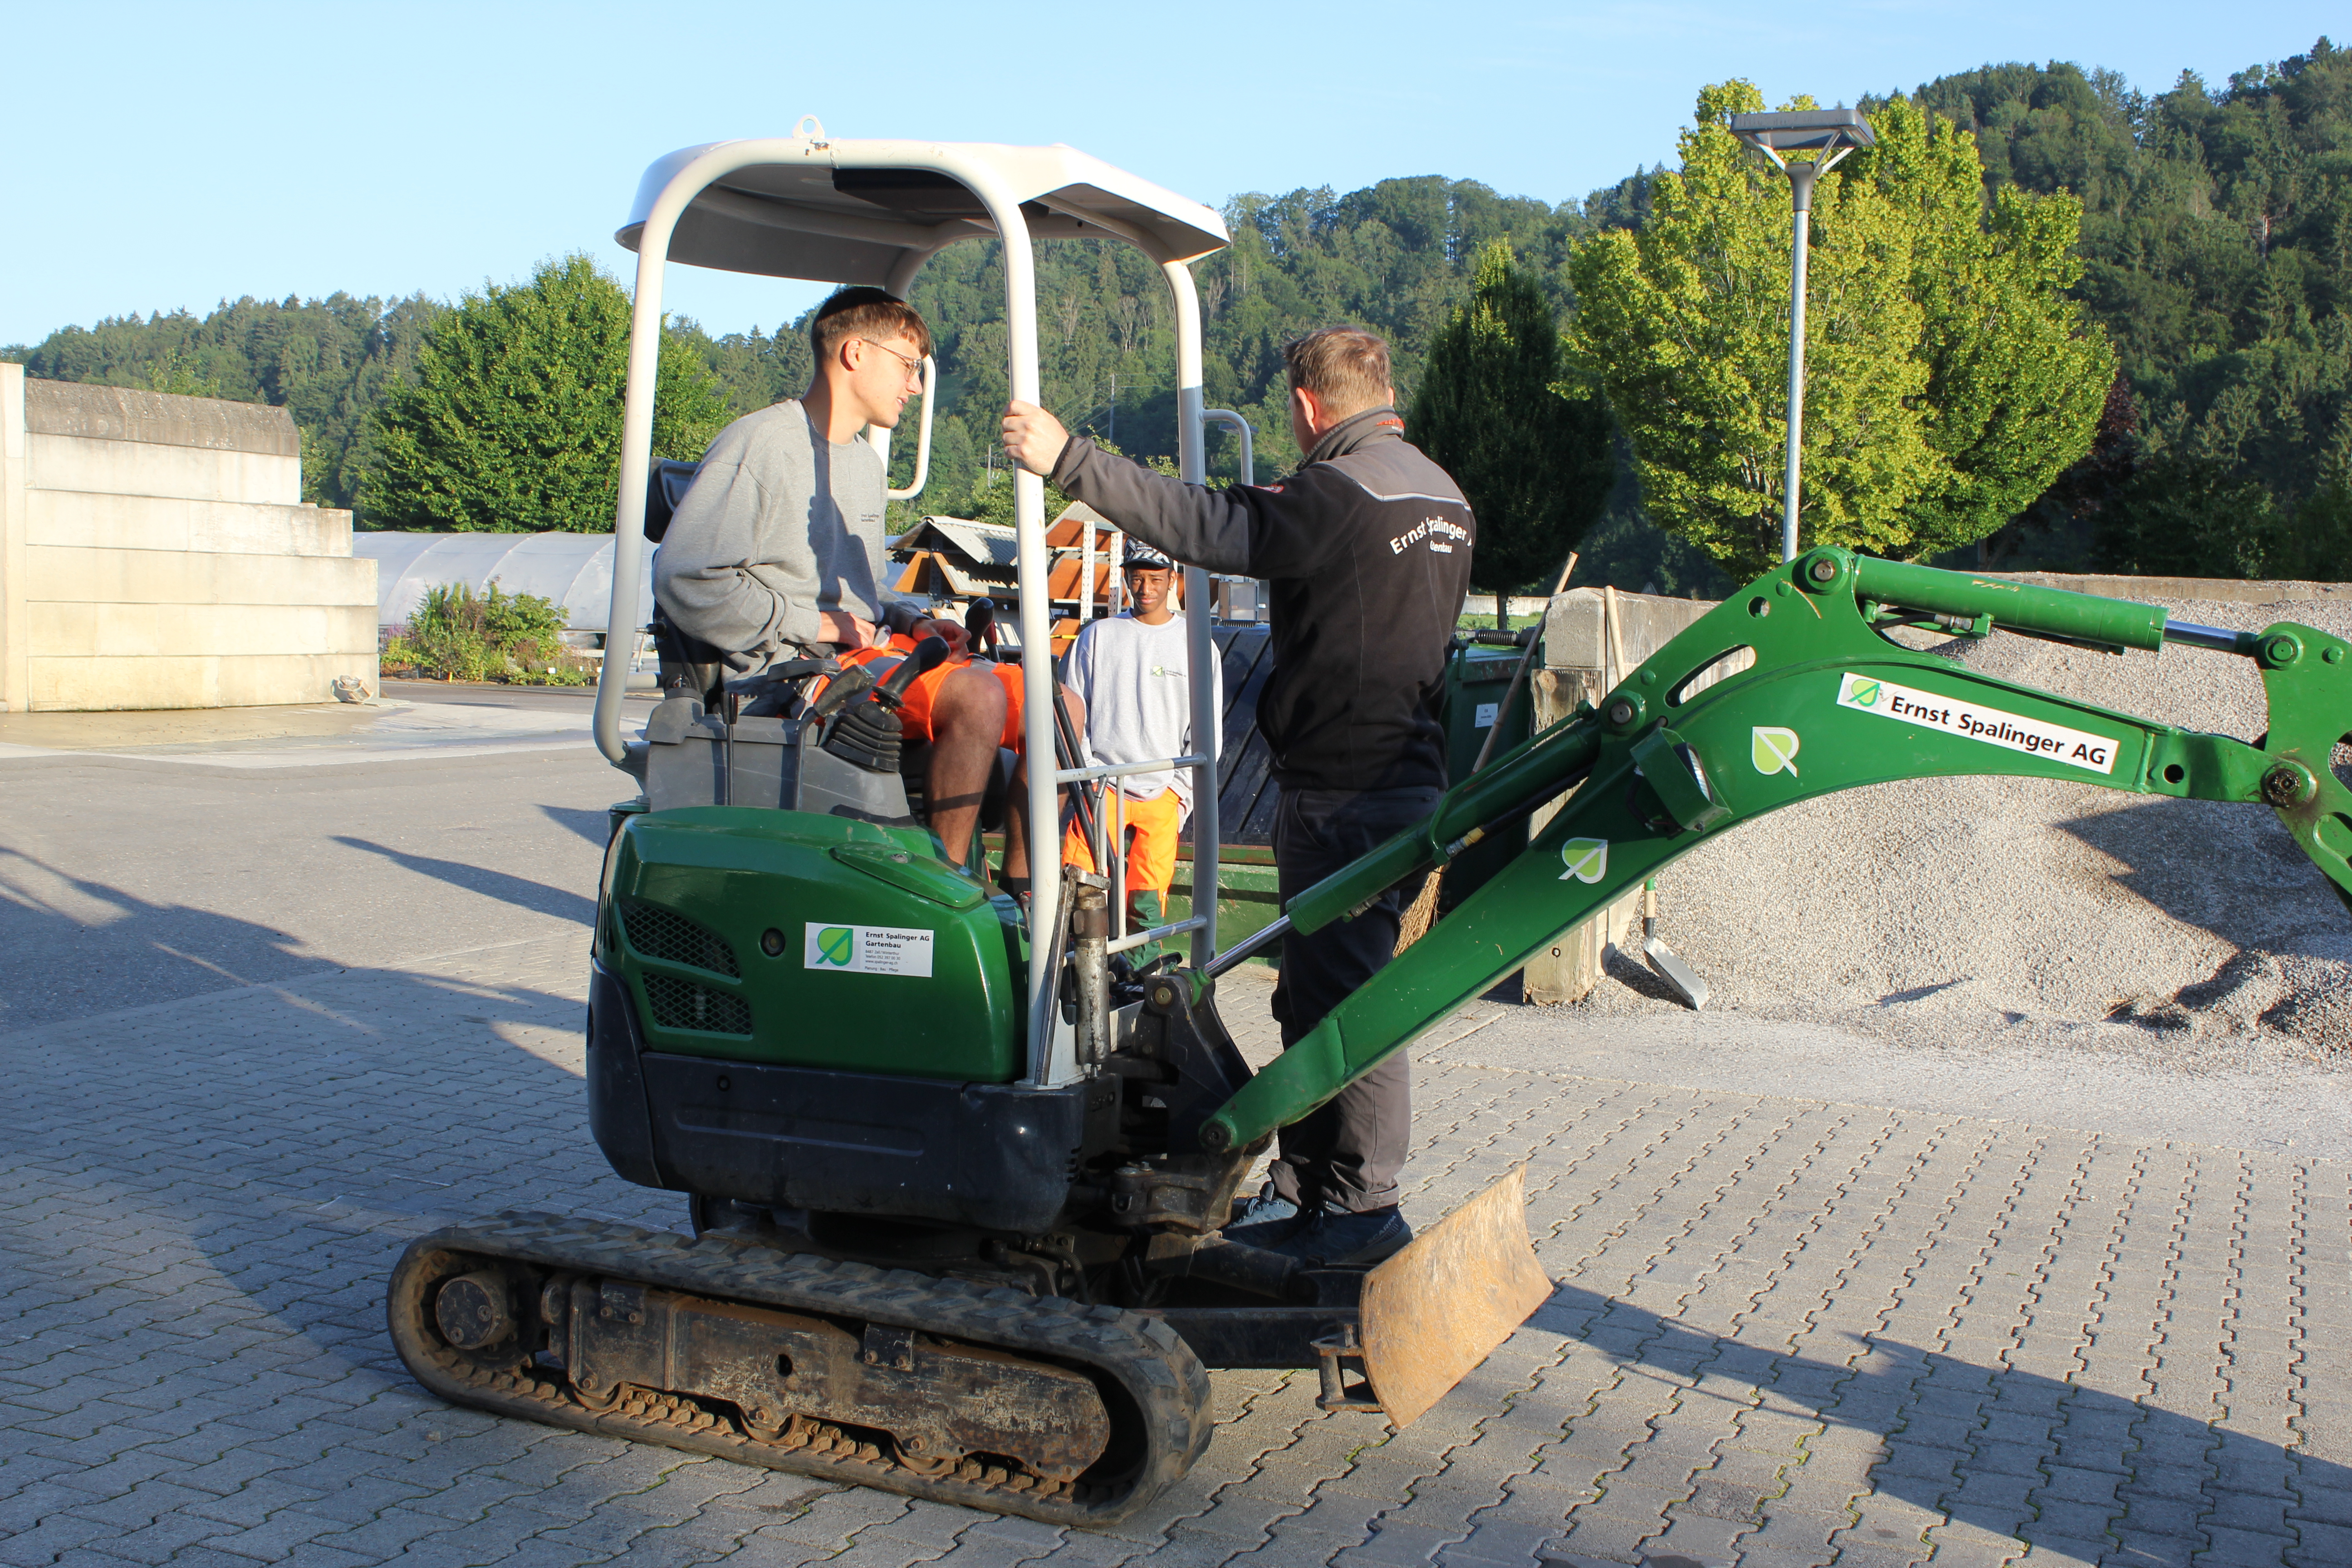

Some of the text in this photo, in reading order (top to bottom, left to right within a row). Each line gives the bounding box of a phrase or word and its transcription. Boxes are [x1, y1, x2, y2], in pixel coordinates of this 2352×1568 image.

[1389, 520, 1426, 555] Ernst
[1891, 696, 2107, 765] Ernst Spalinger AG
[886, 933, 917, 941] Spalinger
